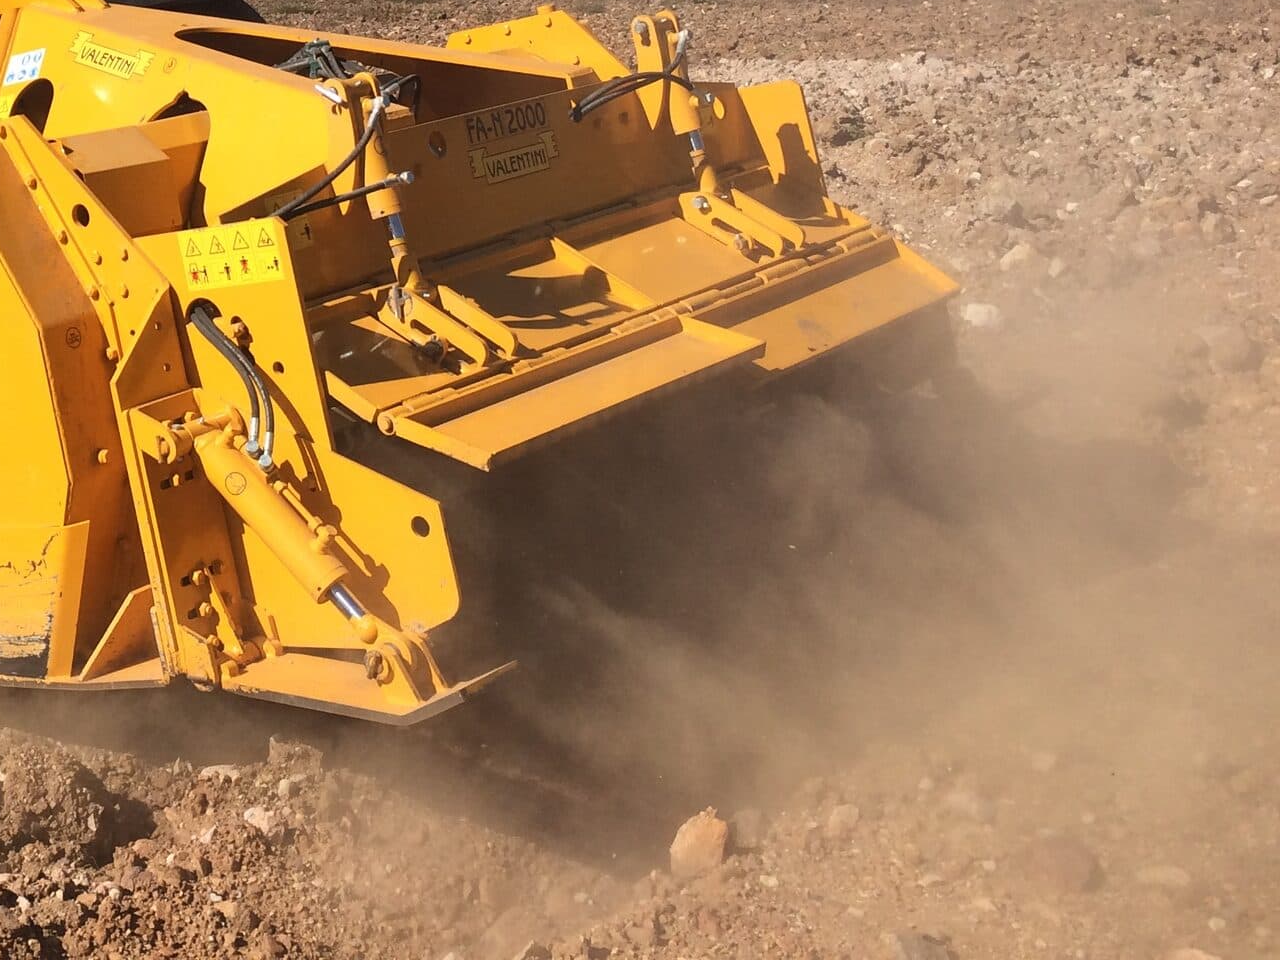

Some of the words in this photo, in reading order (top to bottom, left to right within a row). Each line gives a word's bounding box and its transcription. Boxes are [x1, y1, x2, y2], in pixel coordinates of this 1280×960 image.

[80, 46, 135, 75] VALENTINI
[466, 111, 504, 144] FA-N
[504, 102, 546, 134] 2000
[486, 149, 547, 178] VALENTINI
